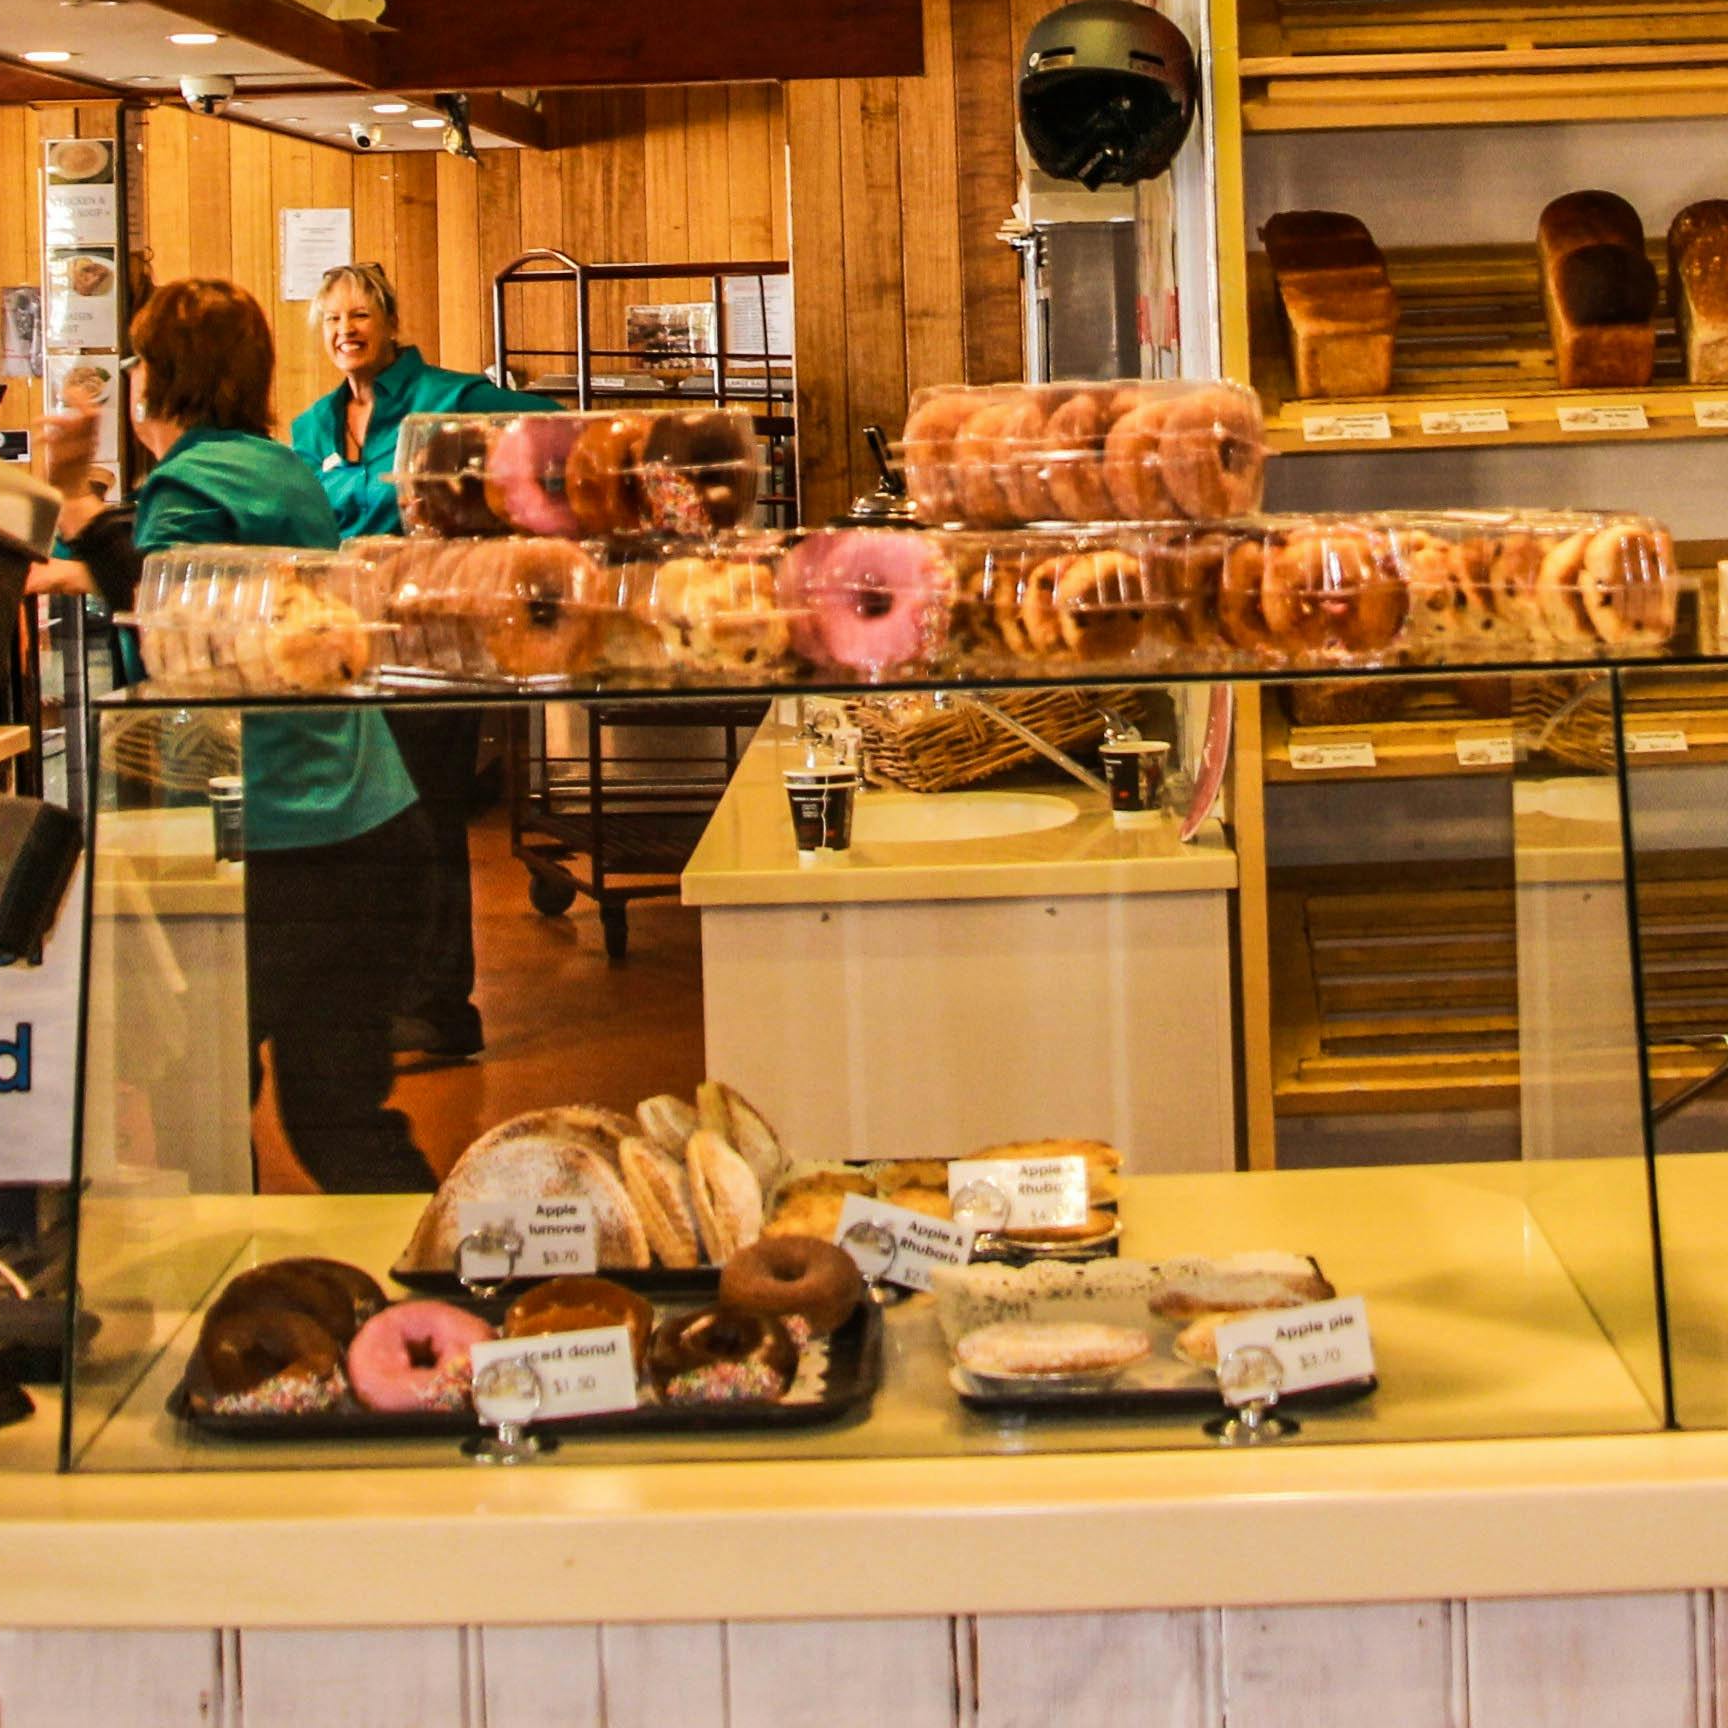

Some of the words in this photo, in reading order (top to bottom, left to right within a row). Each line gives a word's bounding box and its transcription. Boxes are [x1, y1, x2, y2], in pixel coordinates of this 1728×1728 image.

[536, 1204, 578, 1217] Apple
[908, 1220, 951, 1242] Apple
[1275, 1321, 1323, 1341] Apple
[1329, 1315, 1354, 1332] pie
[568, 1341, 616, 1359] donut
